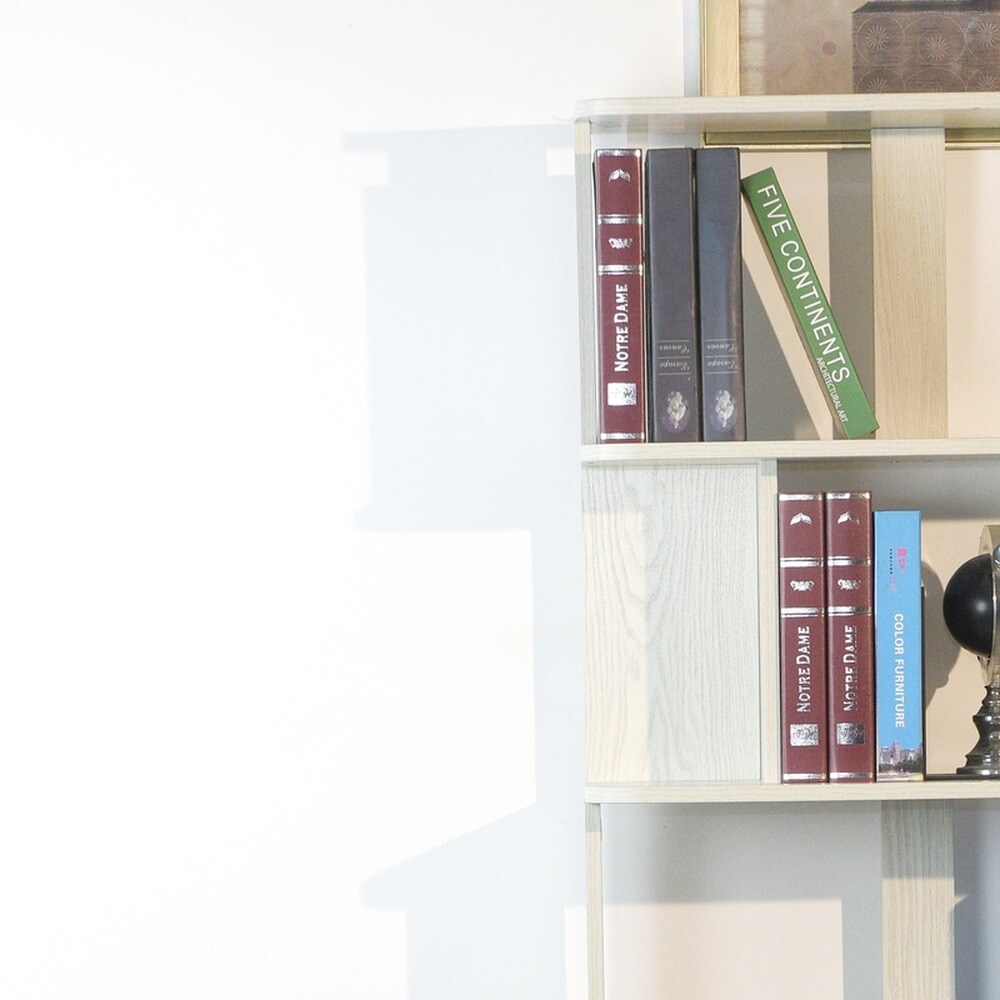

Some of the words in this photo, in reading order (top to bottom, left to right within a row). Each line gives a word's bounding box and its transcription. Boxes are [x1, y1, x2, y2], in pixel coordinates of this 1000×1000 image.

[613, 284, 628, 323] DAME
[757, 183, 792, 237] FIVE
[780, 240, 850, 383] CONTINENTS
[614, 326, 629, 372] NOTRE
[816, 357, 842, 409] ARCHITECTURAL
[838, 409, 849, 422] ART
[796, 625, 811, 662] DAME
[843, 625, 857, 662] DAME
[894, 613, 905, 654] COLOR
[796, 664, 811, 713] NOTRE
[843, 663, 857, 712] NOTRE
[894, 657, 905, 728] FURNITURE
